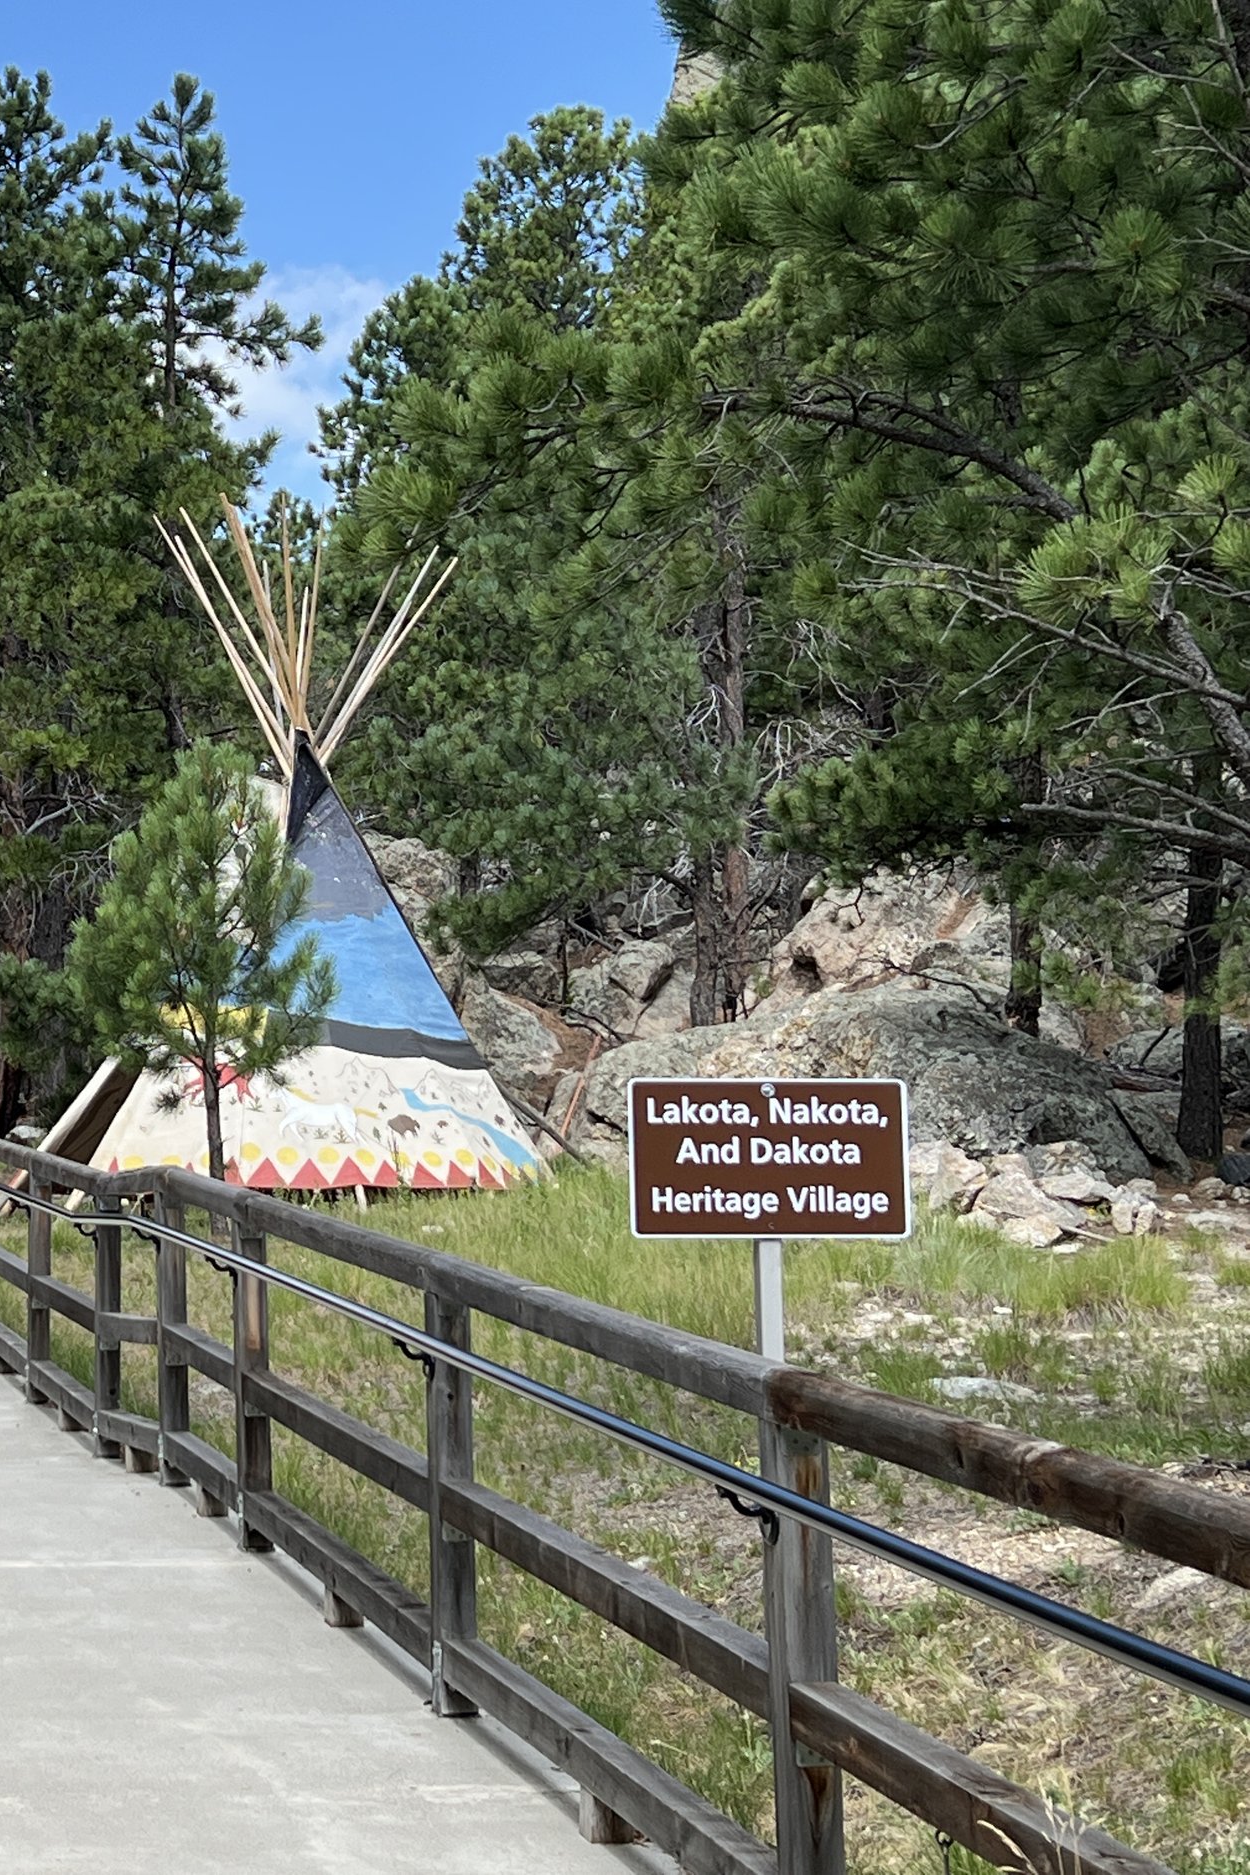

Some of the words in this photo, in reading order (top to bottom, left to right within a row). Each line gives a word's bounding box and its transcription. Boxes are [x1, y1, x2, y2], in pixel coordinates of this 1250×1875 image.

[646, 1095, 759, 1128] Lakota,
[769, 1095, 888, 1128] Nakota,
[676, 1135, 741, 1165] And
[750, 1136, 861, 1165] Dakota
[651, 1185, 779, 1219] Heritage
[786, 1185, 889, 1219] Village
